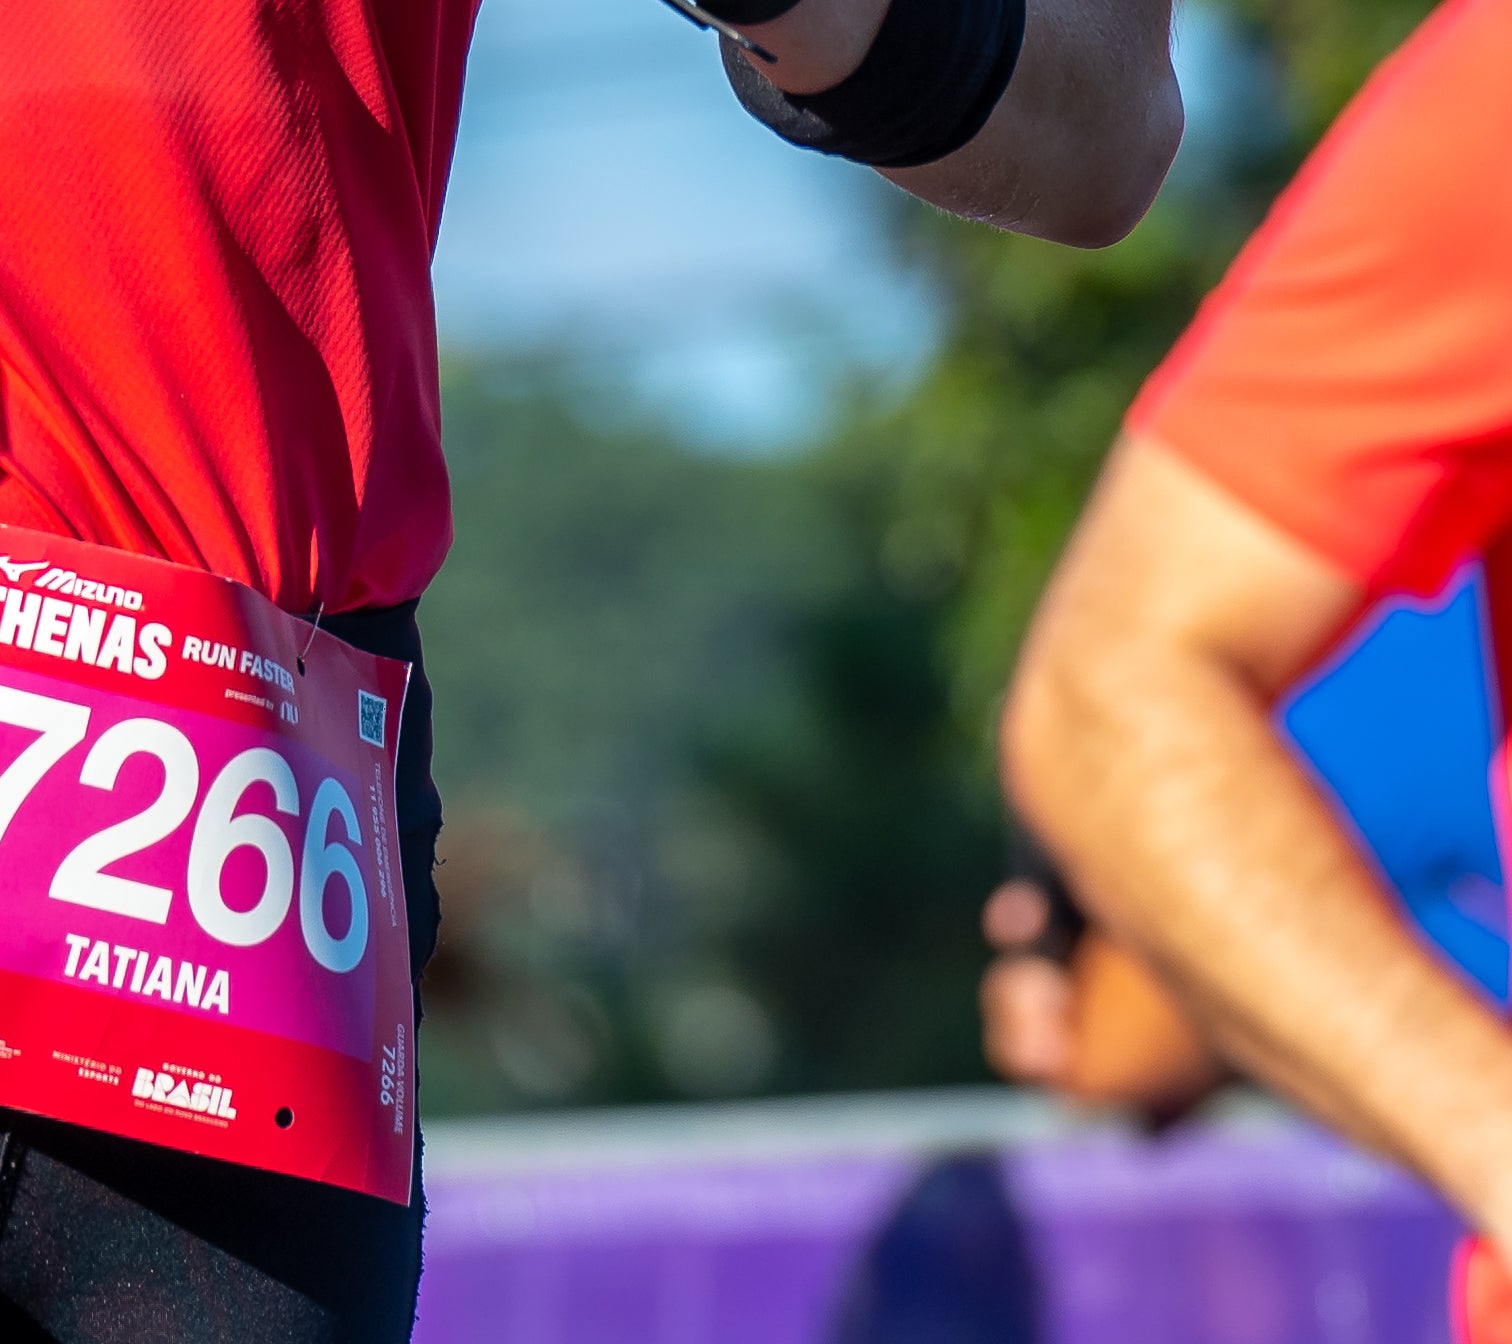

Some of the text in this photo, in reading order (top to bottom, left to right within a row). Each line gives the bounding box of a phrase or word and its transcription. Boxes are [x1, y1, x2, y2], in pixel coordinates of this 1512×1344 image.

[182, 635, 238, 671] RUN
[238, 650, 296, 696] FASTER
[63, 932, 231, 1015] TATIANA
[132, 1066, 237, 1121] BRASIL
[380, 1043, 395, 1106] 7266
